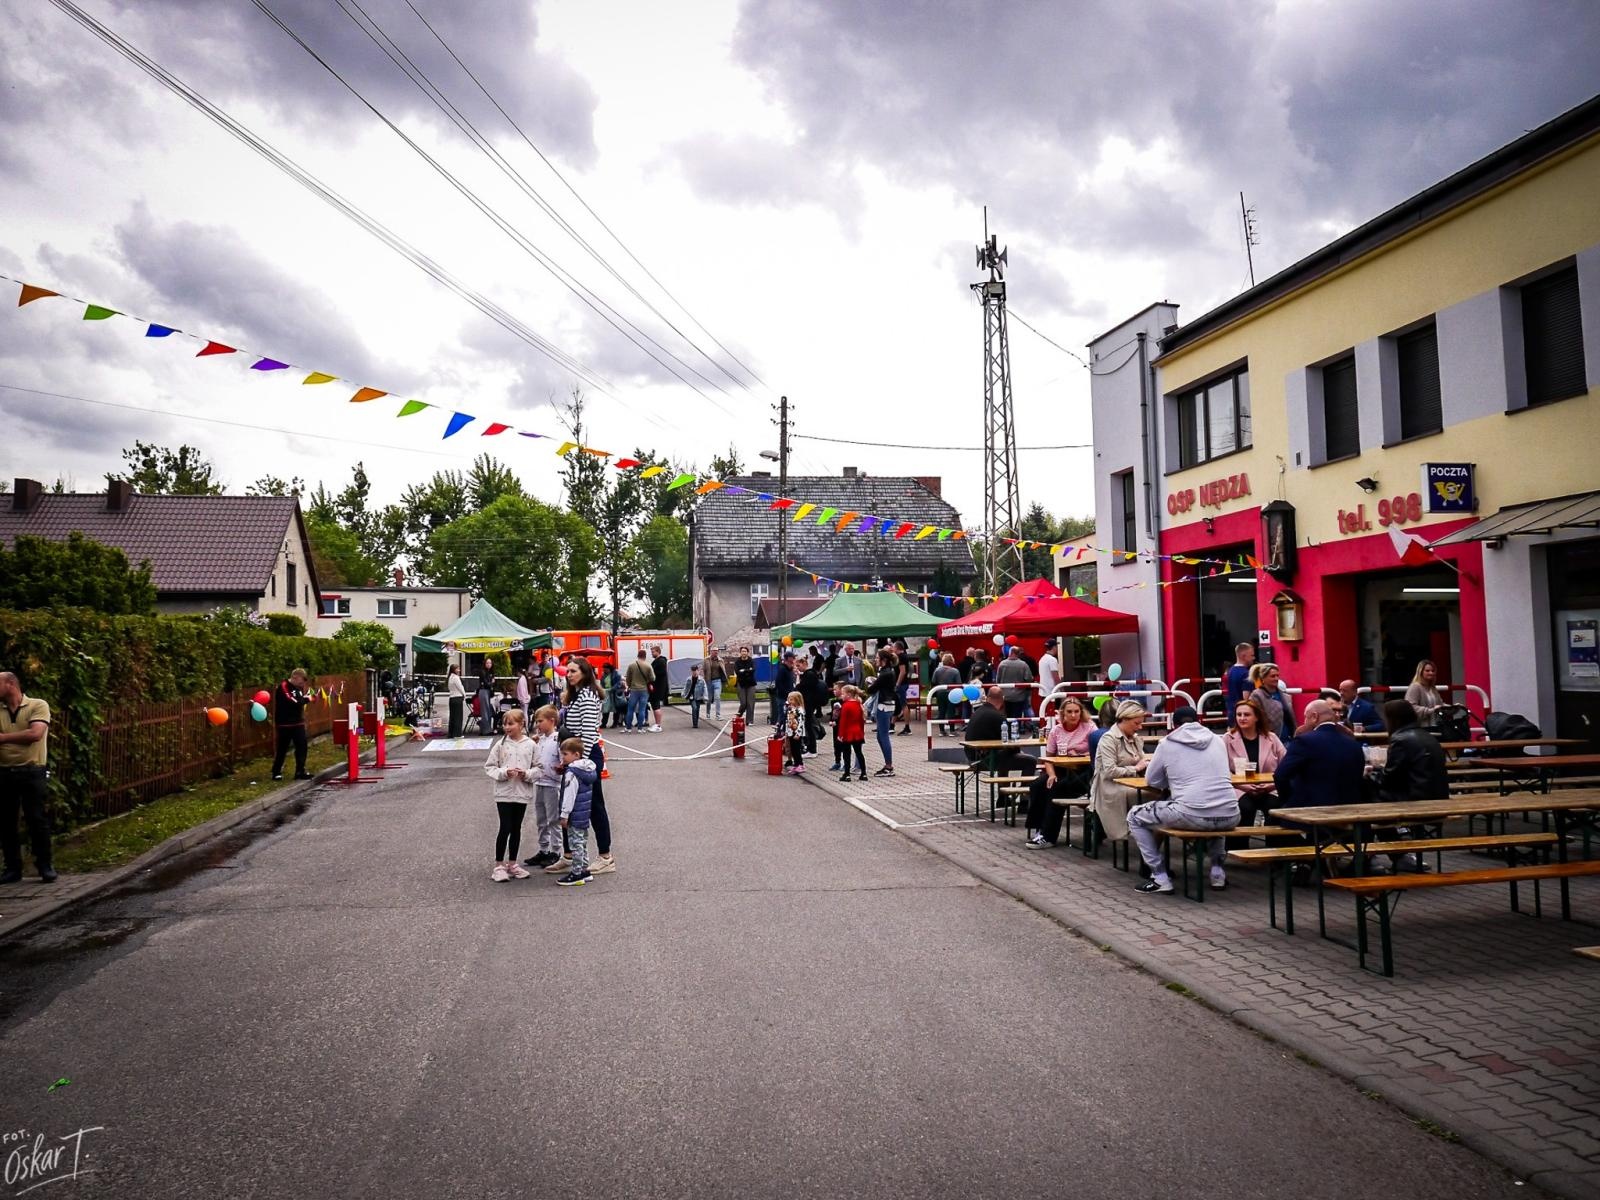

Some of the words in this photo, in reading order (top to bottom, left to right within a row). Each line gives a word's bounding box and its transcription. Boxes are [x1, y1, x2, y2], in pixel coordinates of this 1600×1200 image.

[1430, 467, 1468, 477] POCZTA
[1167, 488, 1196, 516] OSP
[1199, 472, 1252, 510] NĘDZA
[1337, 503, 1372, 535] tel.
[1378, 492, 1423, 527] 998
